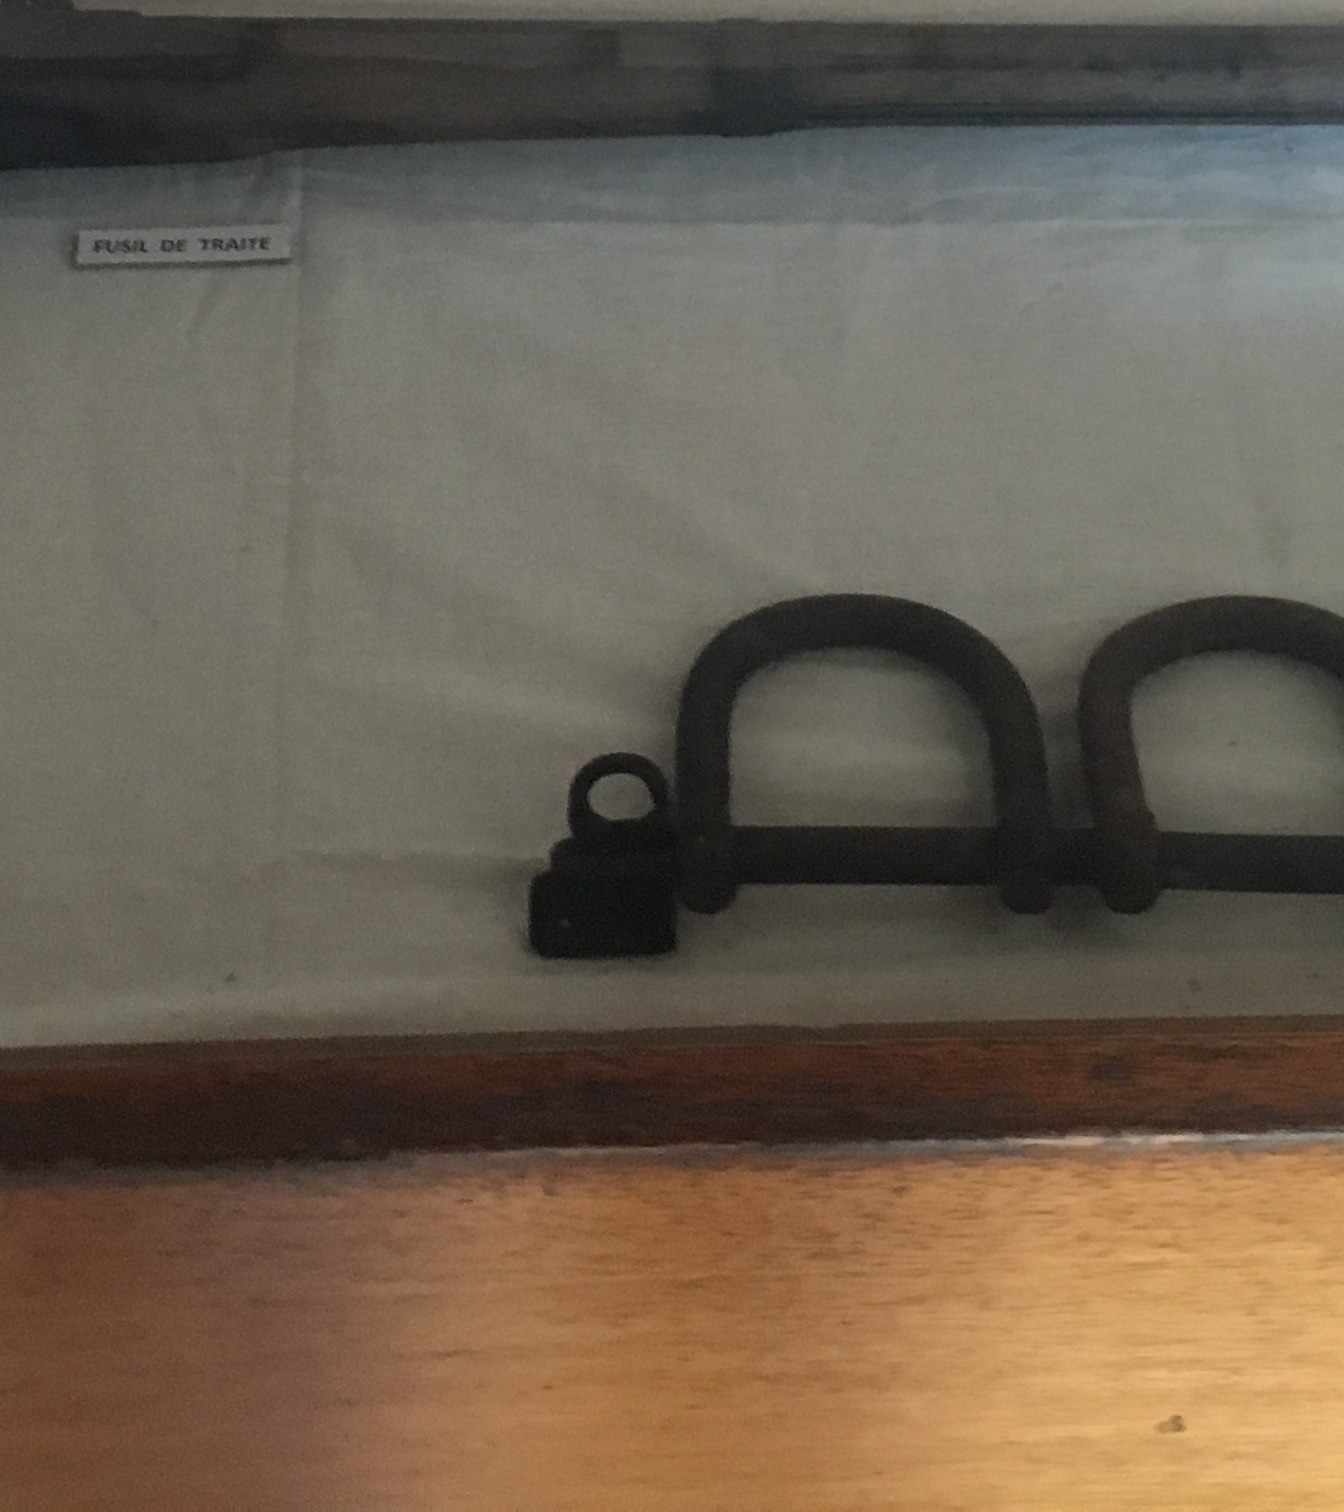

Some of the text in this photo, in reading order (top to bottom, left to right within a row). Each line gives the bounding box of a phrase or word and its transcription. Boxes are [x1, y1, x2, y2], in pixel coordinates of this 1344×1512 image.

[93, 237, 272, 254] FUSIL DE TRAITE
